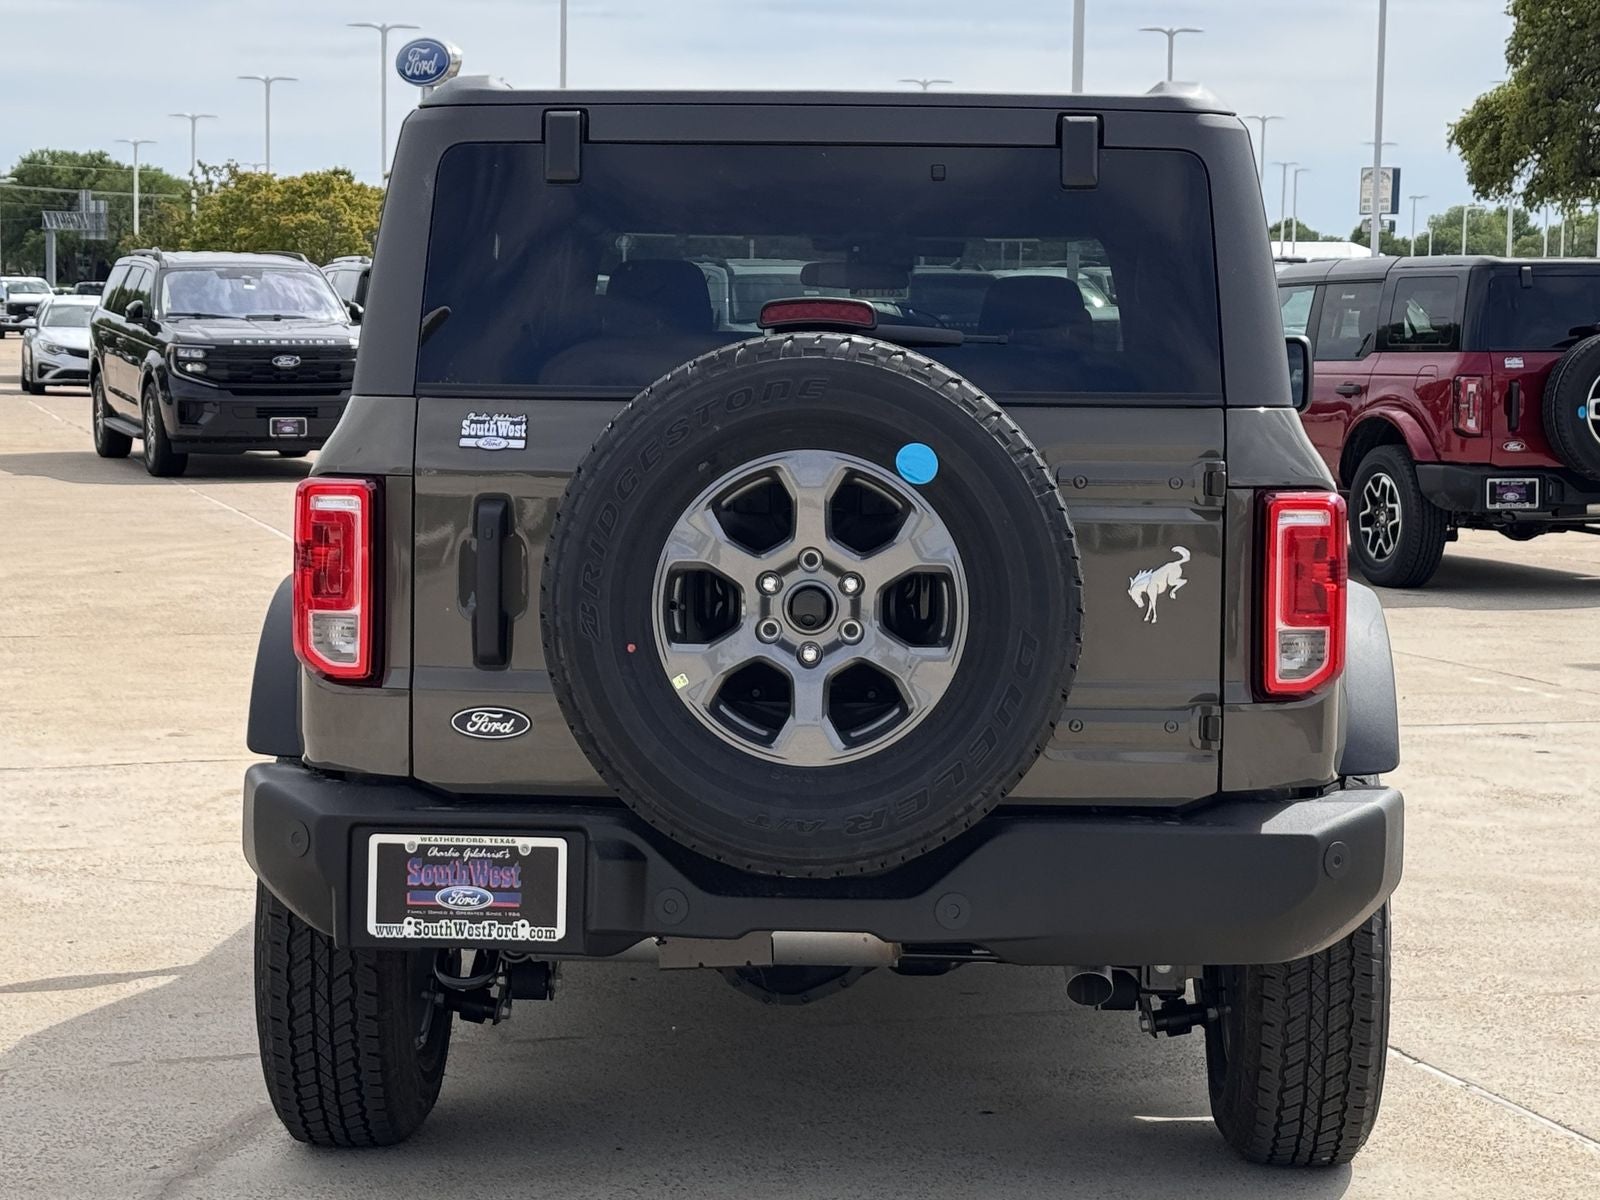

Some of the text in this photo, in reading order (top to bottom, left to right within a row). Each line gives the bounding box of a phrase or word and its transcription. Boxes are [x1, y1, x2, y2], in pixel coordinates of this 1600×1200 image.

[405, 47, 438, 76] Ford
[461, 420, 527, 437] SouthWest
[482, 438, 502, 447] Ford
[576, 376, 829, 641] BRIDGESTONE
[466, 711, 515, 733] Ford
[843, 629, 1040, 836] DUELER
[427, 846, 511, 862] Charlie Gilchrist's
[406, 857, 522, 889] SouthWest
[447, 888, 481, 906] Ford
